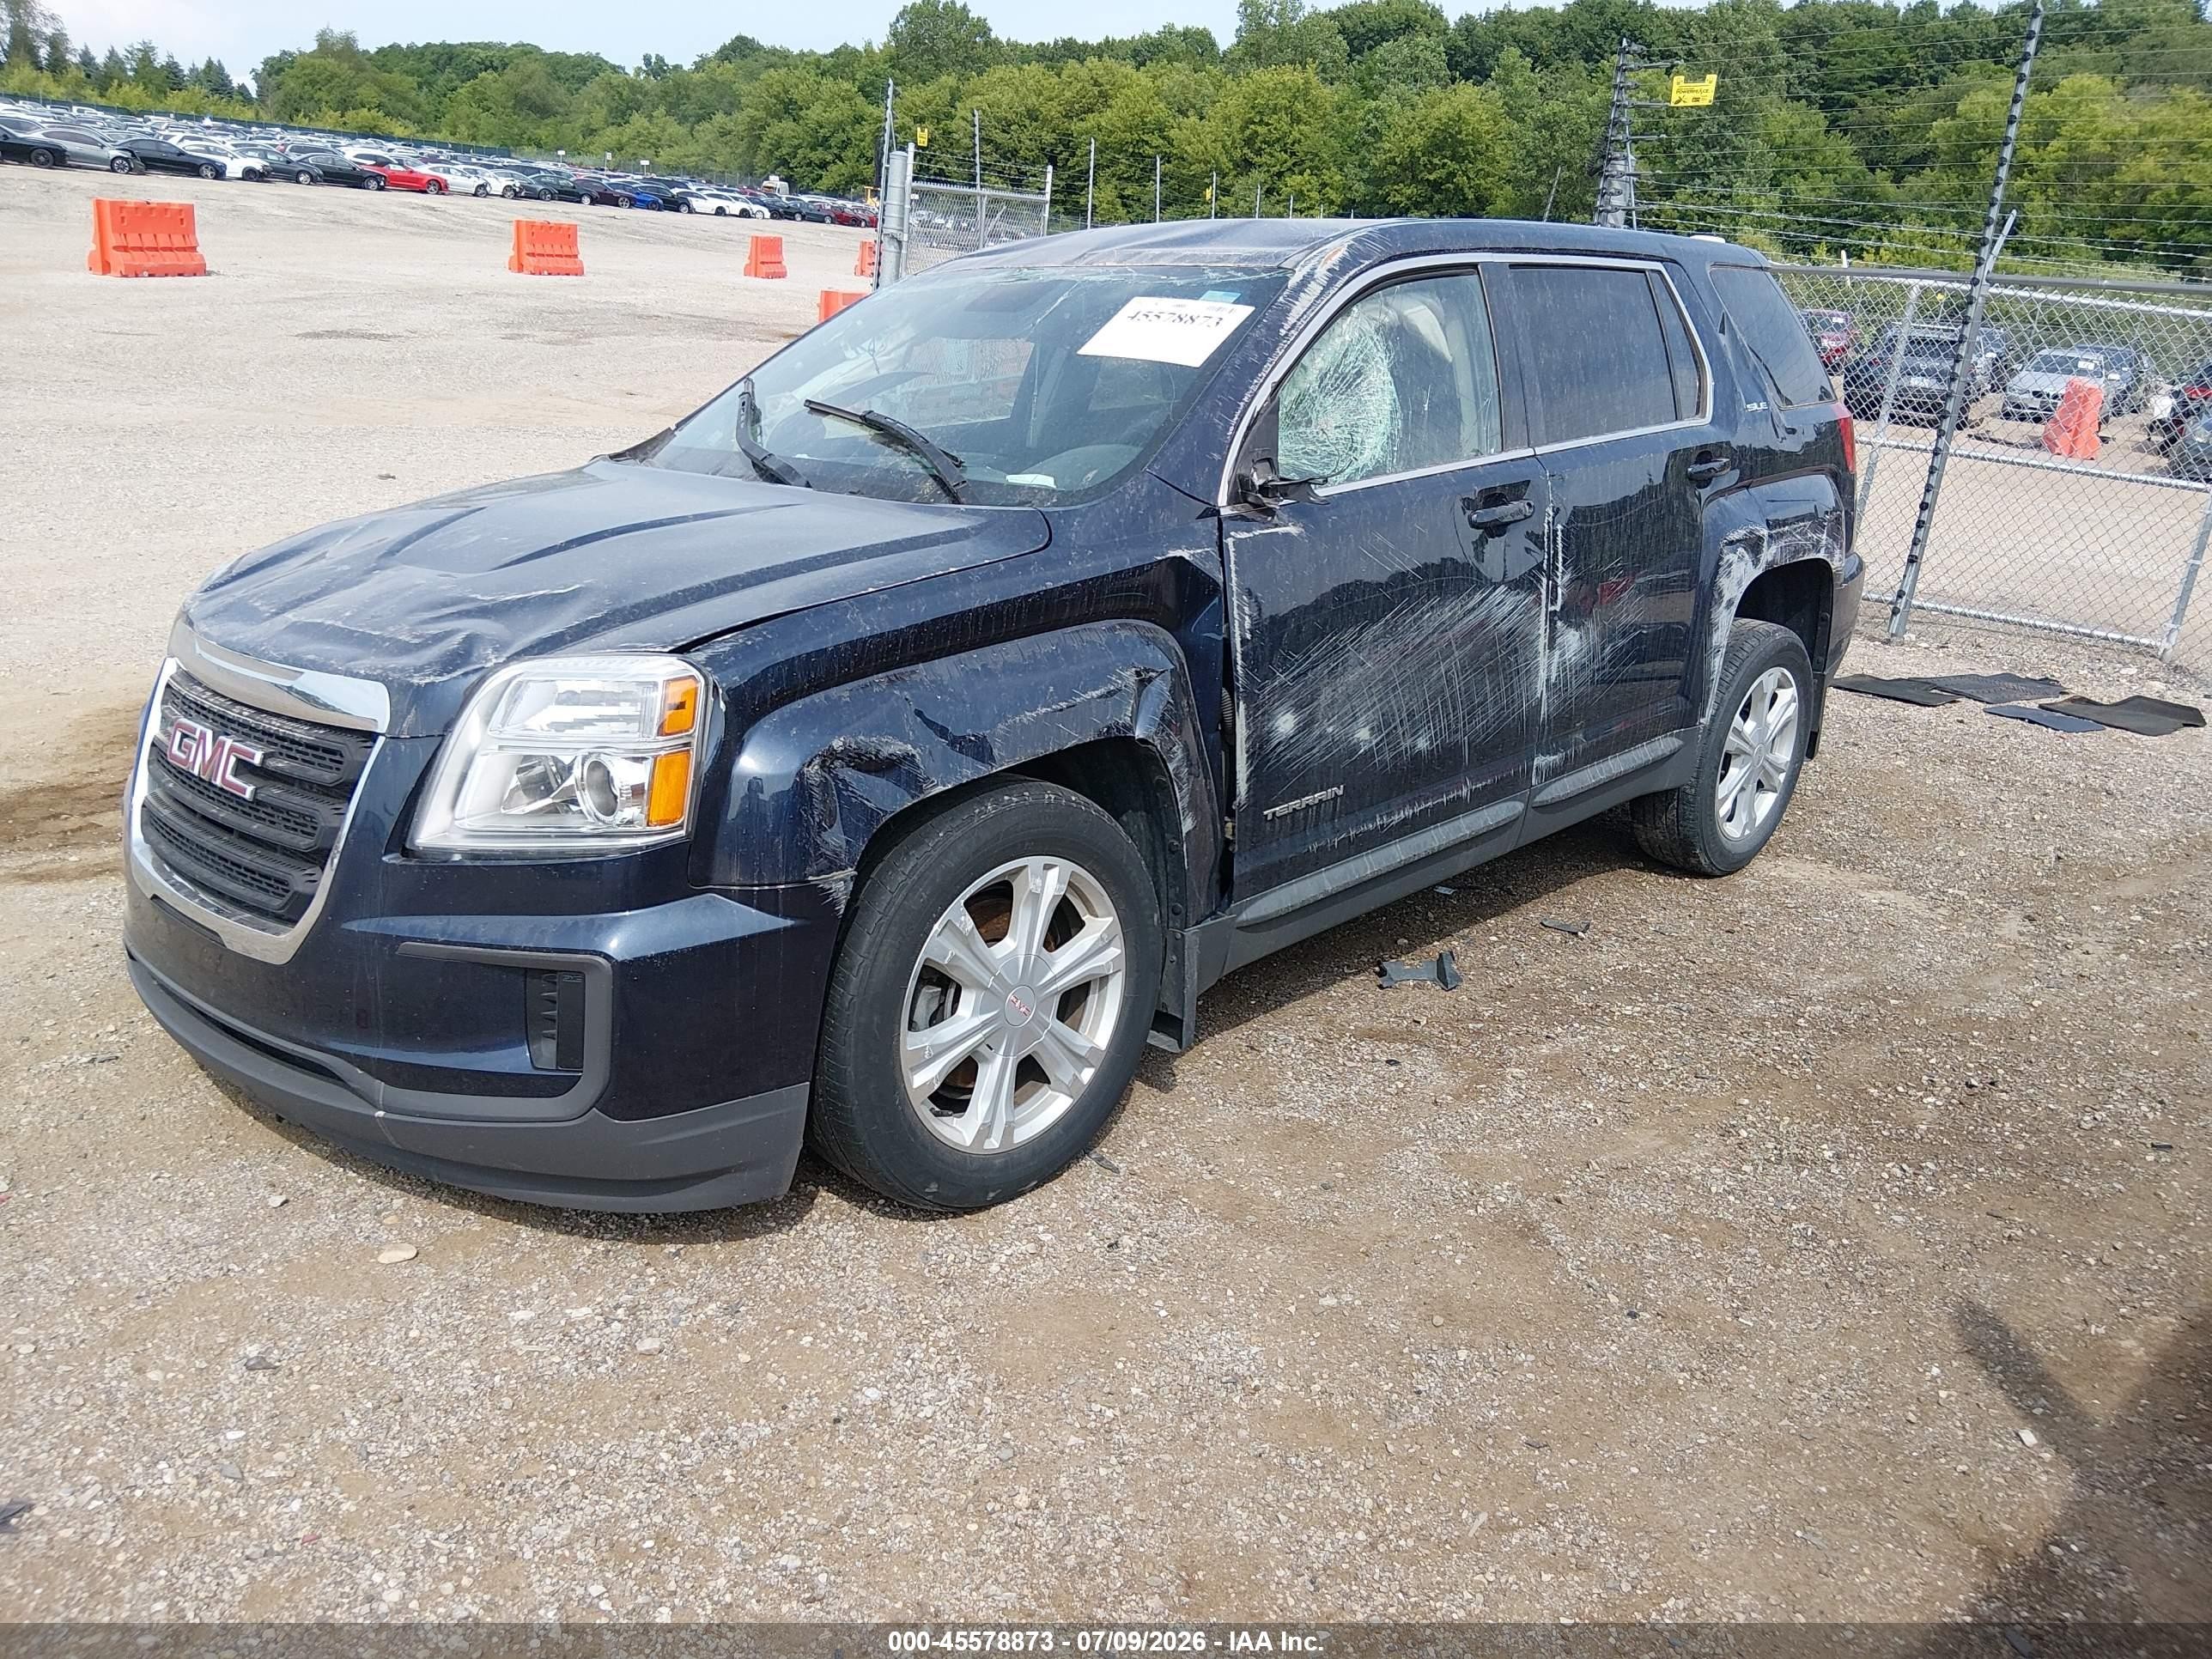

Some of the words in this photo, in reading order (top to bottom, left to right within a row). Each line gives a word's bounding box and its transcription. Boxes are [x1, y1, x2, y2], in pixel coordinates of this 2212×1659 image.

[1127, 309, 1224, 328] 45578873
[1746, 401, 1769, 412] SLE
[167, 718, 264, 801] GMC
[1262, 784, 1345, 821] TERRAIN
